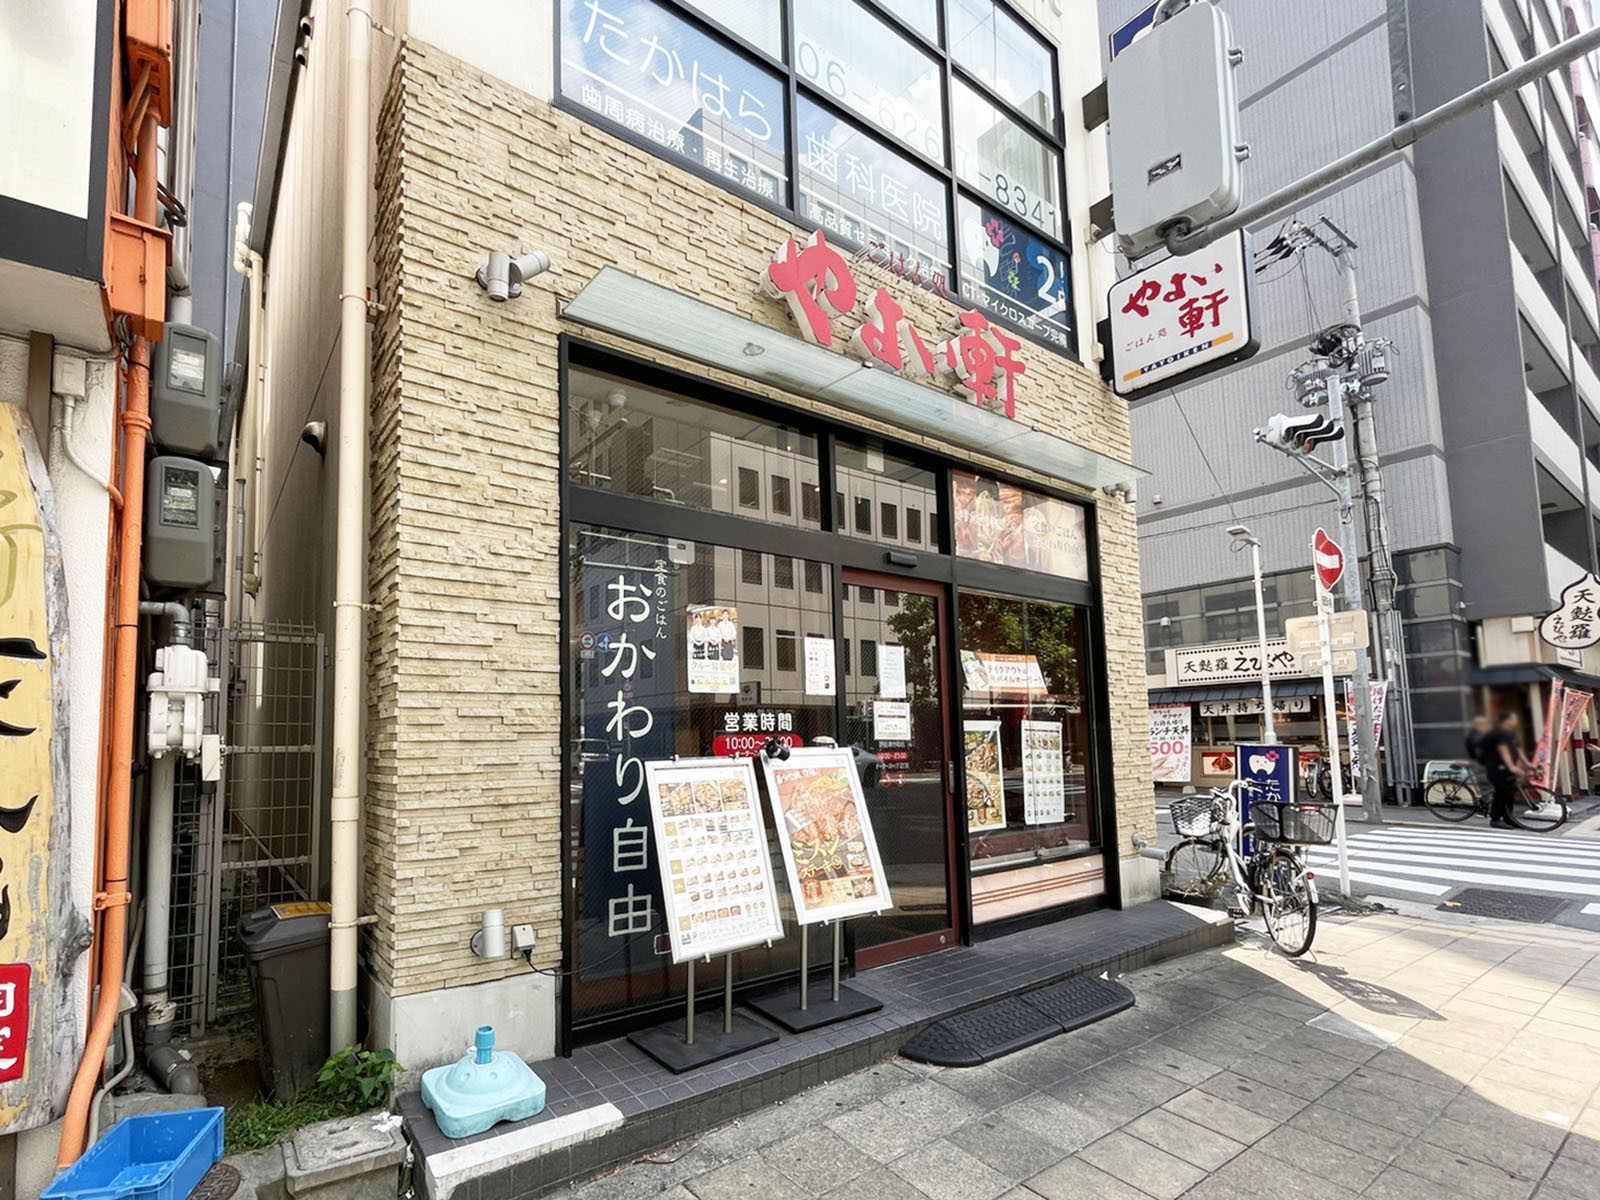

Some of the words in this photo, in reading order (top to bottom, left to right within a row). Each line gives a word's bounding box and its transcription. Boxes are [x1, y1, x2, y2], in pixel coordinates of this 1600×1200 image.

[583, 0, 772, 142] たかはら
[805, 130, 942, 241] 歯科医院
[764, 228, 1027, 420] やよい軒
[1142, 341, 1210, 375] YAYOIKEN
[654, 558, 669, 640] 定食のごはん
[601, 574, 657, 938] おかわり自由
[724, 711, 792, 732] 営業時間
